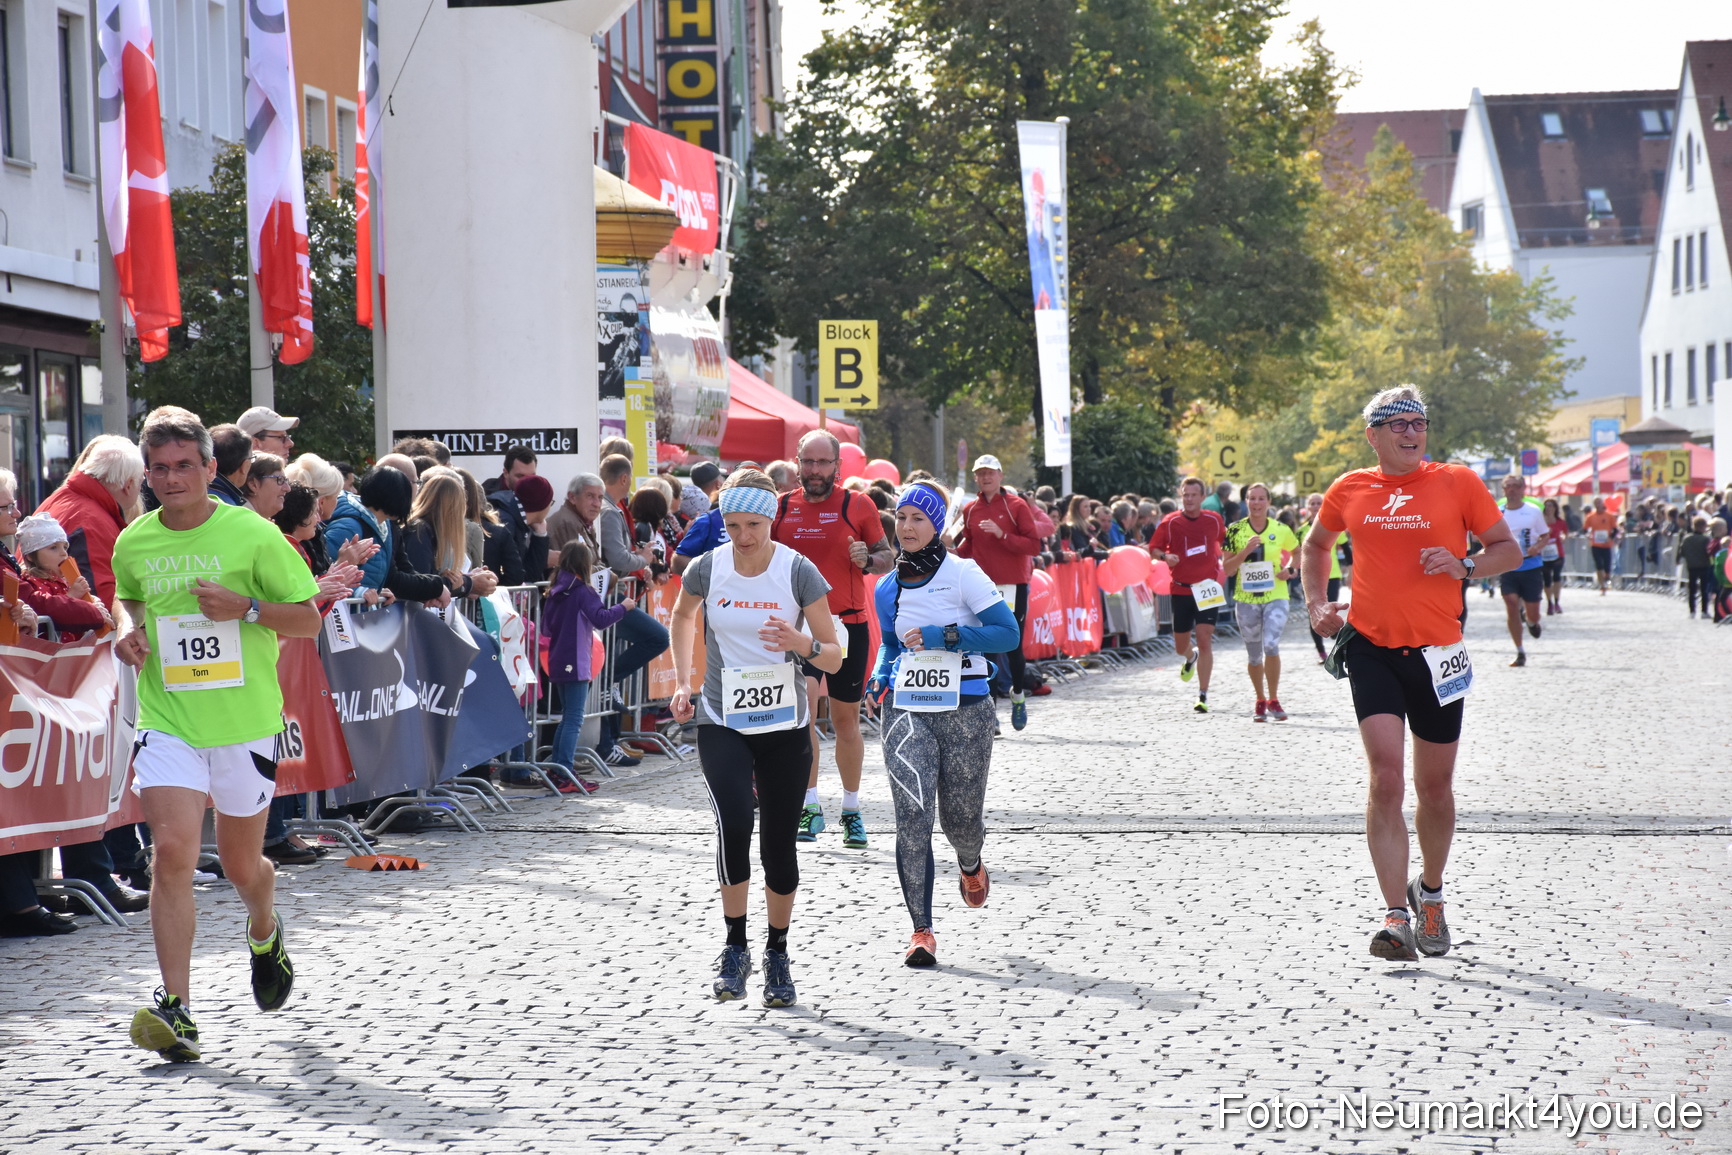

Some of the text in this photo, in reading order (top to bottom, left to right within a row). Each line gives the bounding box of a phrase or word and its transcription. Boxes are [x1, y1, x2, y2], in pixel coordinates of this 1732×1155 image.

[611, 323, 623, 333] CUP
[826, 324, 871, 340] Block
[834, 347, 863, 390] B
[1215, 433, 1240, 441] Block
[1220, 446, 1236, 469] C
[1673, 461, 1686, 477] D
[1303, 471, 1316, 488] D
[1363, 514, 1422, 525] funrunners
[1381, 521, 1431, 530] neumarkt
[145, 554, 223, 574] NOVINA
[1245, 570, 1270, 581] 2686
[147, 575, 220, 596] HOTE
[1200, 586, 1218, 599] 219
[734, 601, 782, 610] KLEBL
[332, 607, 344, 633] swn
[177, 636, 220, 660] 193
[192, 668, 209, 677] Tom
[904, 669, 950, 688] 2065
[733, 684, 784, 709] 2387
[910, 694, 943, 702] Franziska
[748, 713, 775, 723] Kerstin
